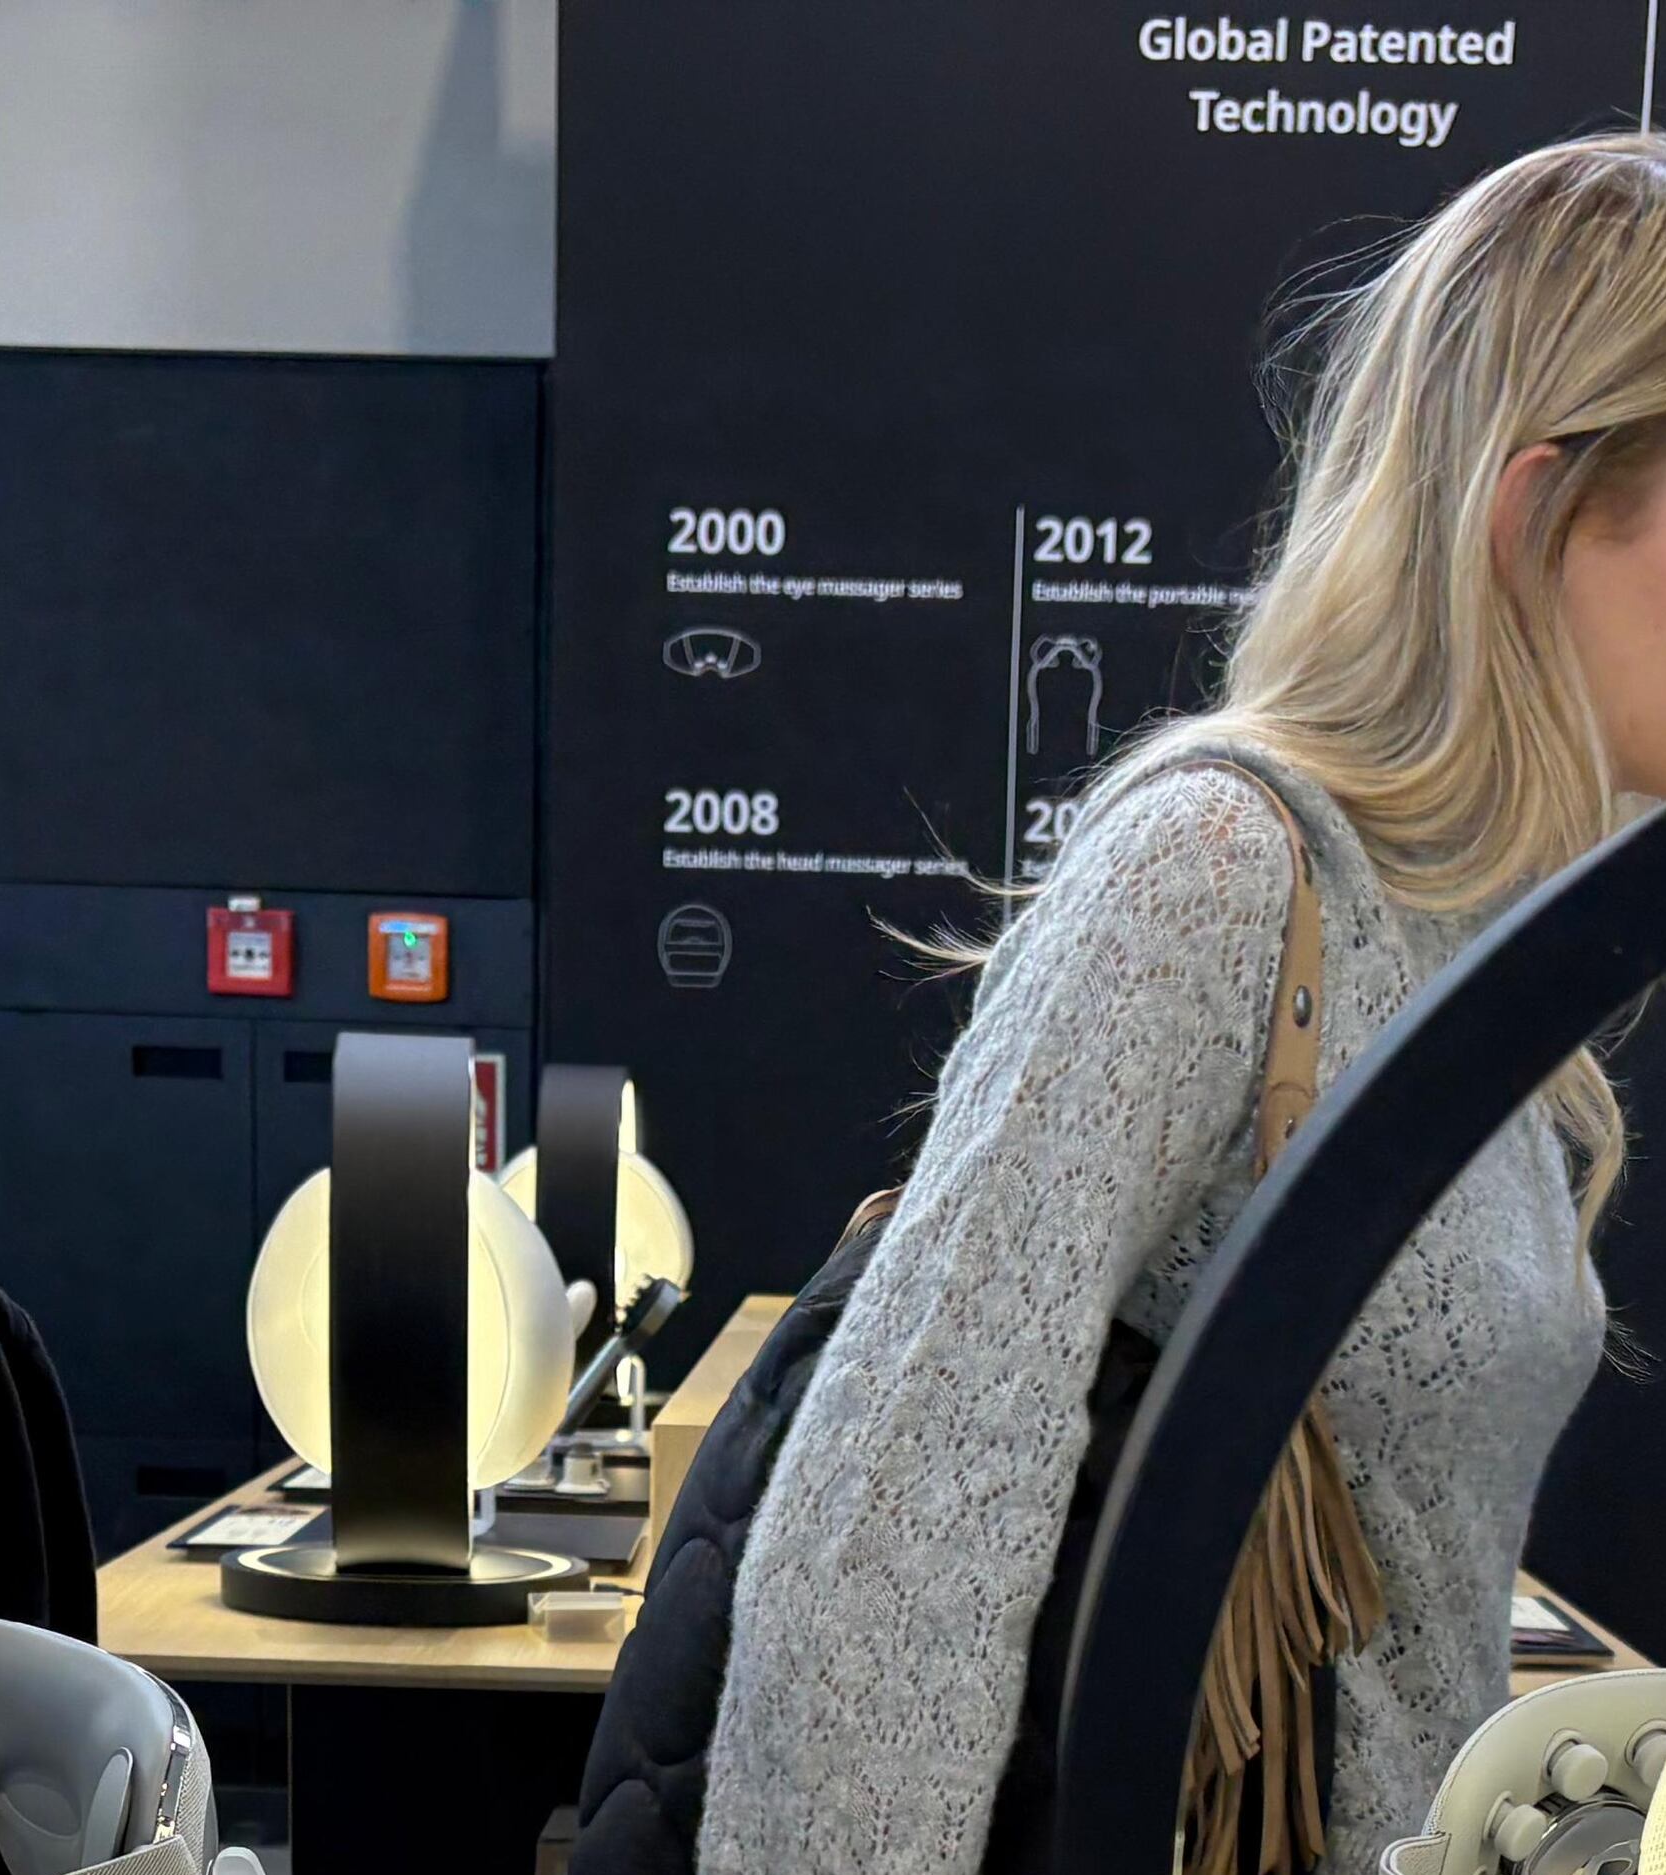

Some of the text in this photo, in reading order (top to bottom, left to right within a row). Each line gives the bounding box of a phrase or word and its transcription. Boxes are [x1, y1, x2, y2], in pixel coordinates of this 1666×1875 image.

[1139, 16, 1516, 65] Global Patented
[1189, 88, 1458, 148] Technology
[667, 508, 786, 556] 2000
[1034, 516, 1152, 565] 2012
[667, 571, 747, 594] Establish
[749, 572, 780, 595] the
[783, 577, 816, 600] eye
[907, 578, 964, 599] series
[1033, 580, 1113, 603] Establish
[1115, 581, 1146, 604] the
[663, 789, 780, 836] 2008
[663, 848, 742, 870] Establish
[744, 849, 775, 871] the
[777, 850, 824, 872] head
